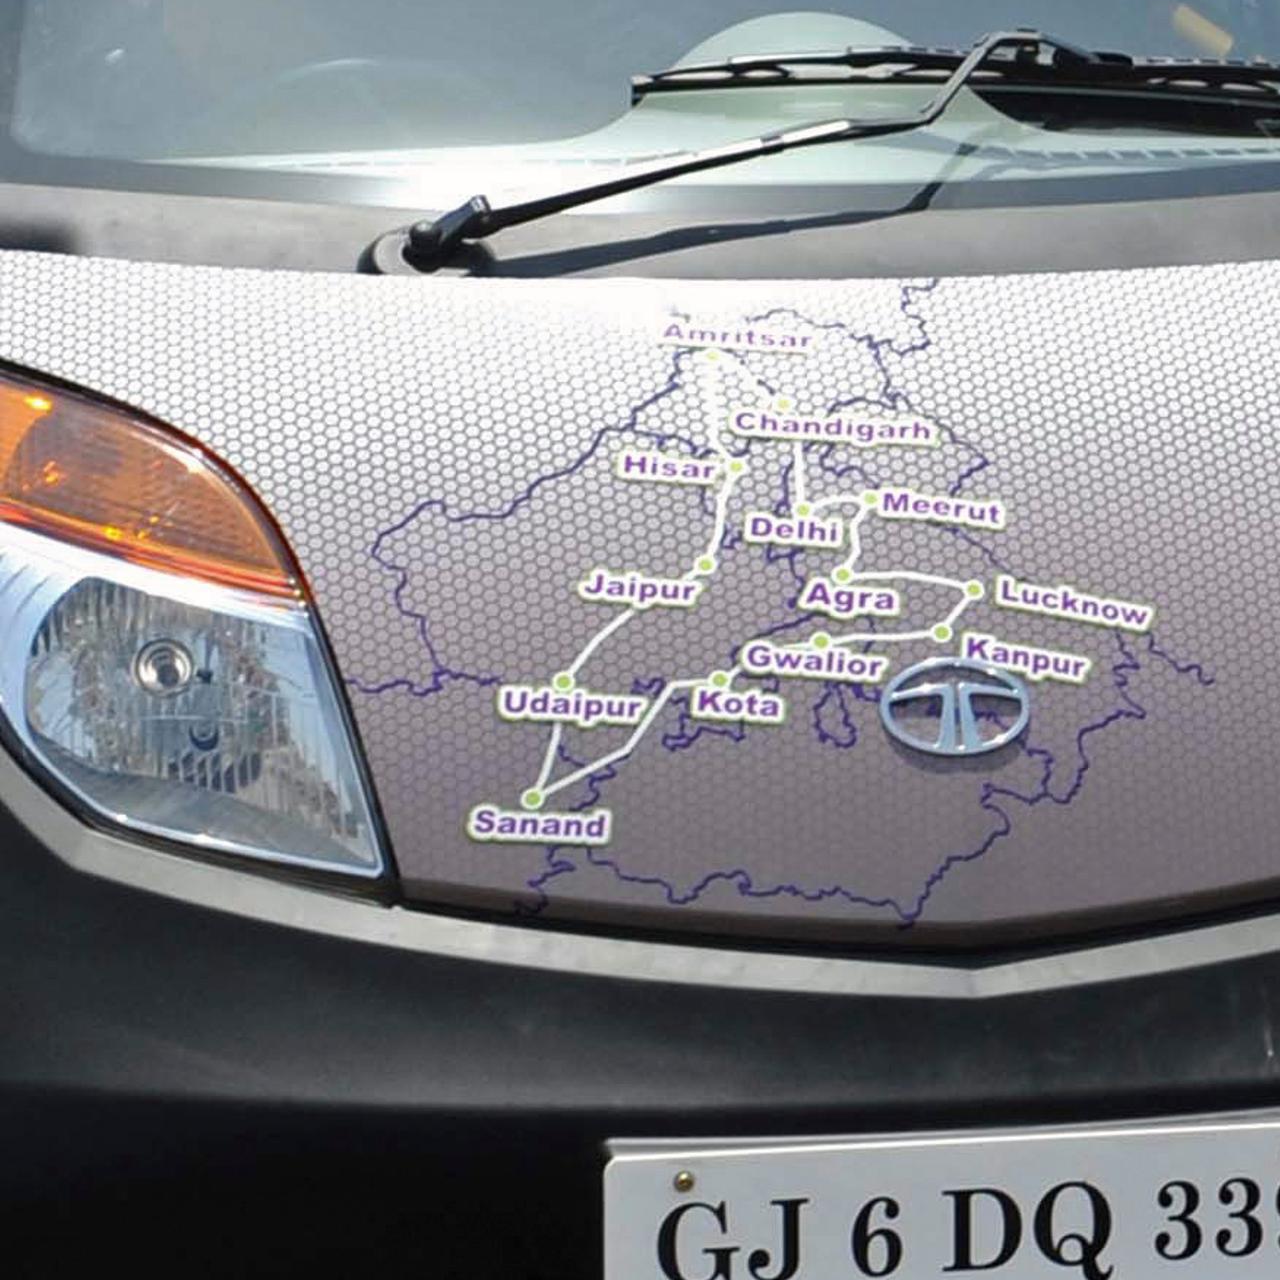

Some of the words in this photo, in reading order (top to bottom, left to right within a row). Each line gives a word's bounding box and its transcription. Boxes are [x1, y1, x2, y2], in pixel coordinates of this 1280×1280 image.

[663, 323, 812, 347] Amritsar
[736, 412, 931, 442] Chandigarh
[624, 455, 716, 480] Hisar
[882, 492, 1001, 525] Meerut
[750, 517, 839, 543] Delhi
[582, 574, 698, 605] Jaipur
[806, 582, 896, 613] Agra
[1001, 580, 1149, 626] Lucknow
[746, 645, 883, 680] Gwalior
[965, 636, 1086, 680] Kanpur
[502, 691, 643, 722] Udaipur
[698, 690, 781, 719] Kota
[473, 810, 606, 839] Sanand
[850, 1196, 903, 1277] 6
